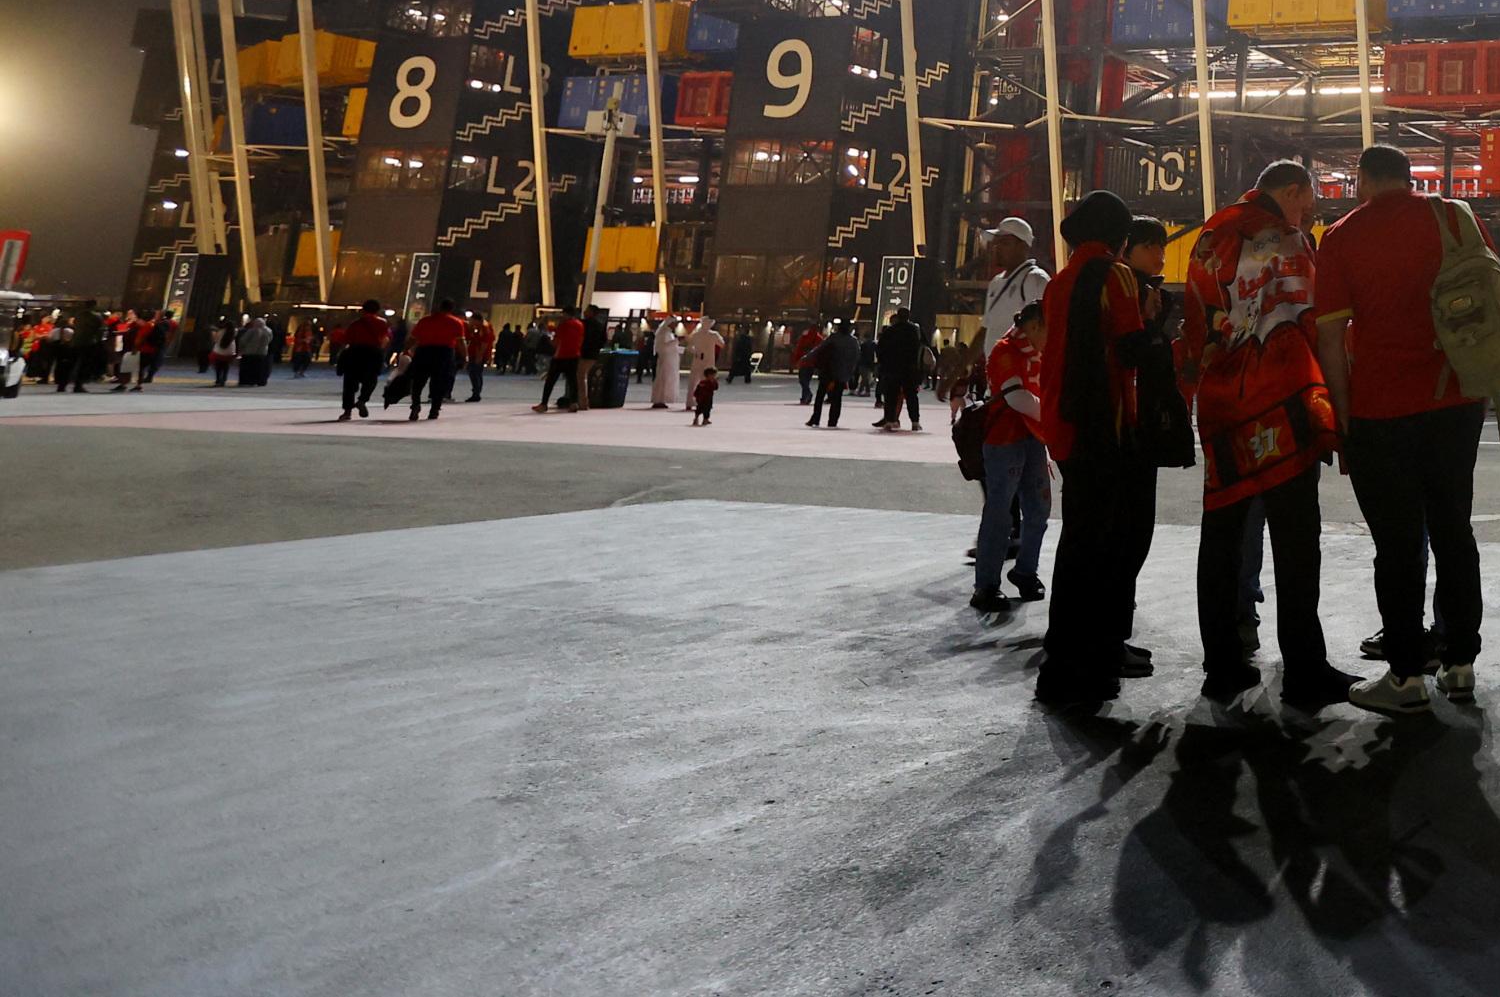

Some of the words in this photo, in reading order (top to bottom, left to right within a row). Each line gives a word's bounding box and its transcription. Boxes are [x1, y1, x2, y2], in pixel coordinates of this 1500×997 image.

[388, 55, 437, 129] 8
[763, 38, 814, 118] 9
[487, 156, 536, 200] L2
[867, 148, 907, 195] L2
[1139, 151, 1185, 192] 10
[179, 262, 190, 277] 8
[419, 262, 430, 278] 9
[470, 260, 522, 300] L1
[887, 266, 909, 285] 10
[1248, 427, 1275, 459] 37
